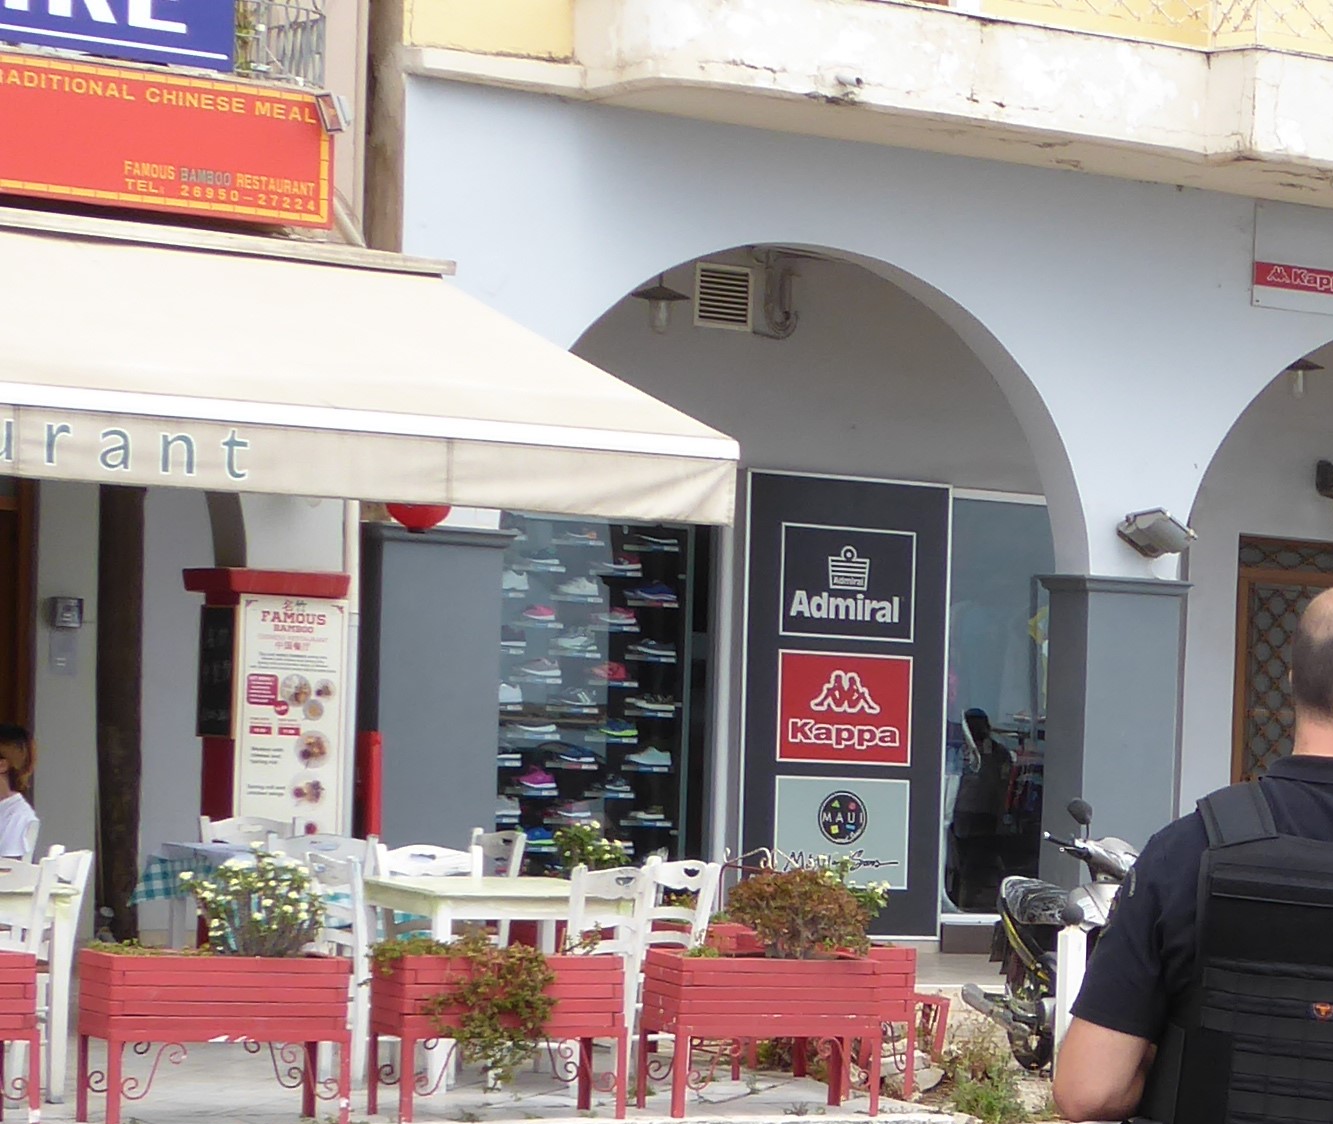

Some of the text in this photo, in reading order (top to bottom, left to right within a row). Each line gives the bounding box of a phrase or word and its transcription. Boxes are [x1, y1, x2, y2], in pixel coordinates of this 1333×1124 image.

[146, 87, 245, 114] CHINESE
[255, 101, 316, 124] MEAL
[124, 160, 315, 197] FAMOUS BAMBOO RESTAURANT
[834, 576, 864, 586] Admiral
[261, 610, 326, 625] FAMOUS
[789, 590, 900, 623] Admiral
[789, 718, 900, 749] Kappa
[822, 812, 863, 823] MAUI
